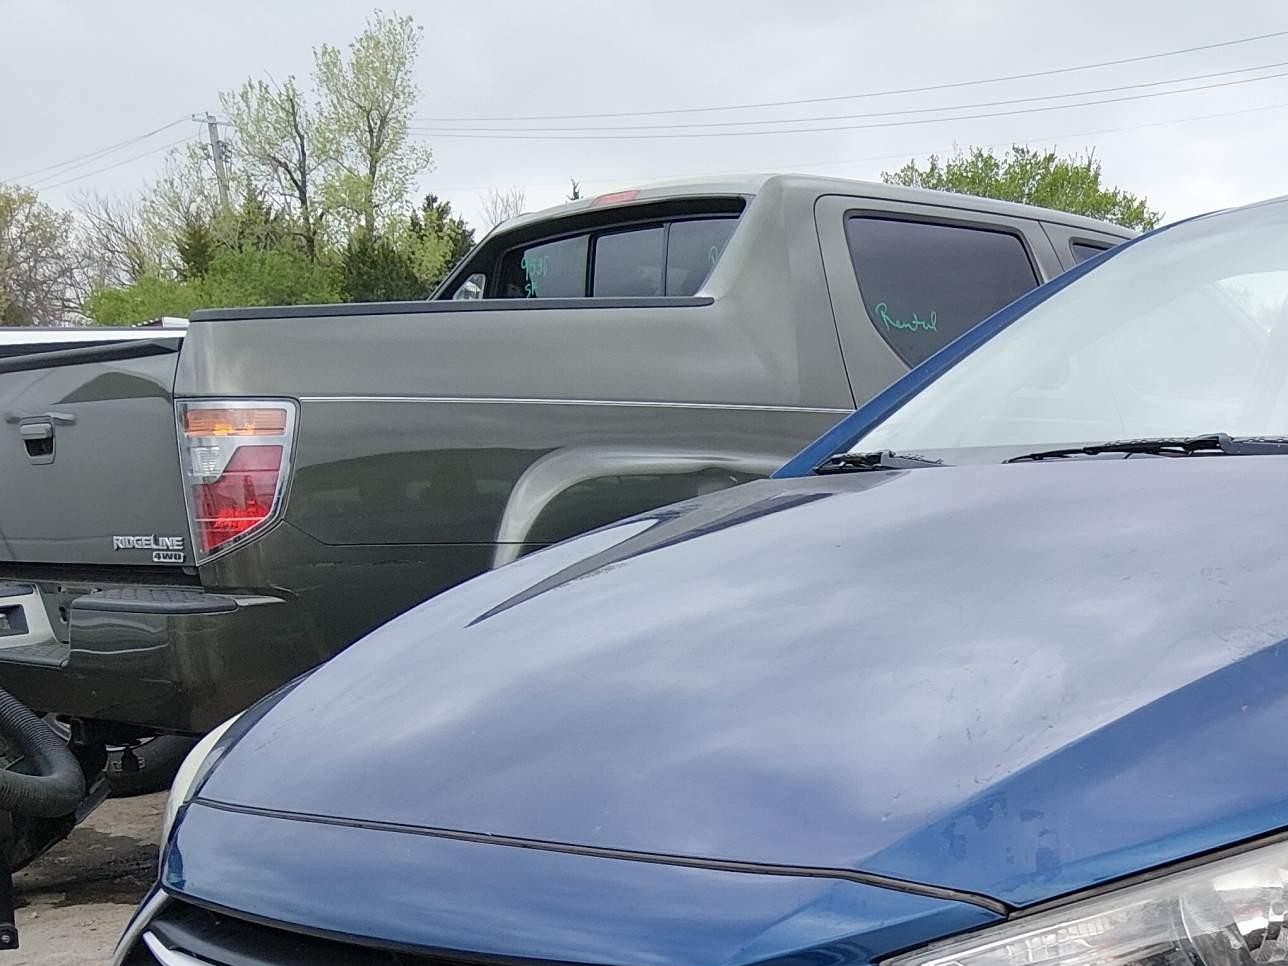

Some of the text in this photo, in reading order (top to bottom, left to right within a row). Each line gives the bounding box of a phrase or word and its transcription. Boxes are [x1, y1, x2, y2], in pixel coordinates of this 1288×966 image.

[875, 302, 937, 332] Rental
[112, 534, 184, 551] RIDGELINE
[154, 552, 182, 560] 4WD
